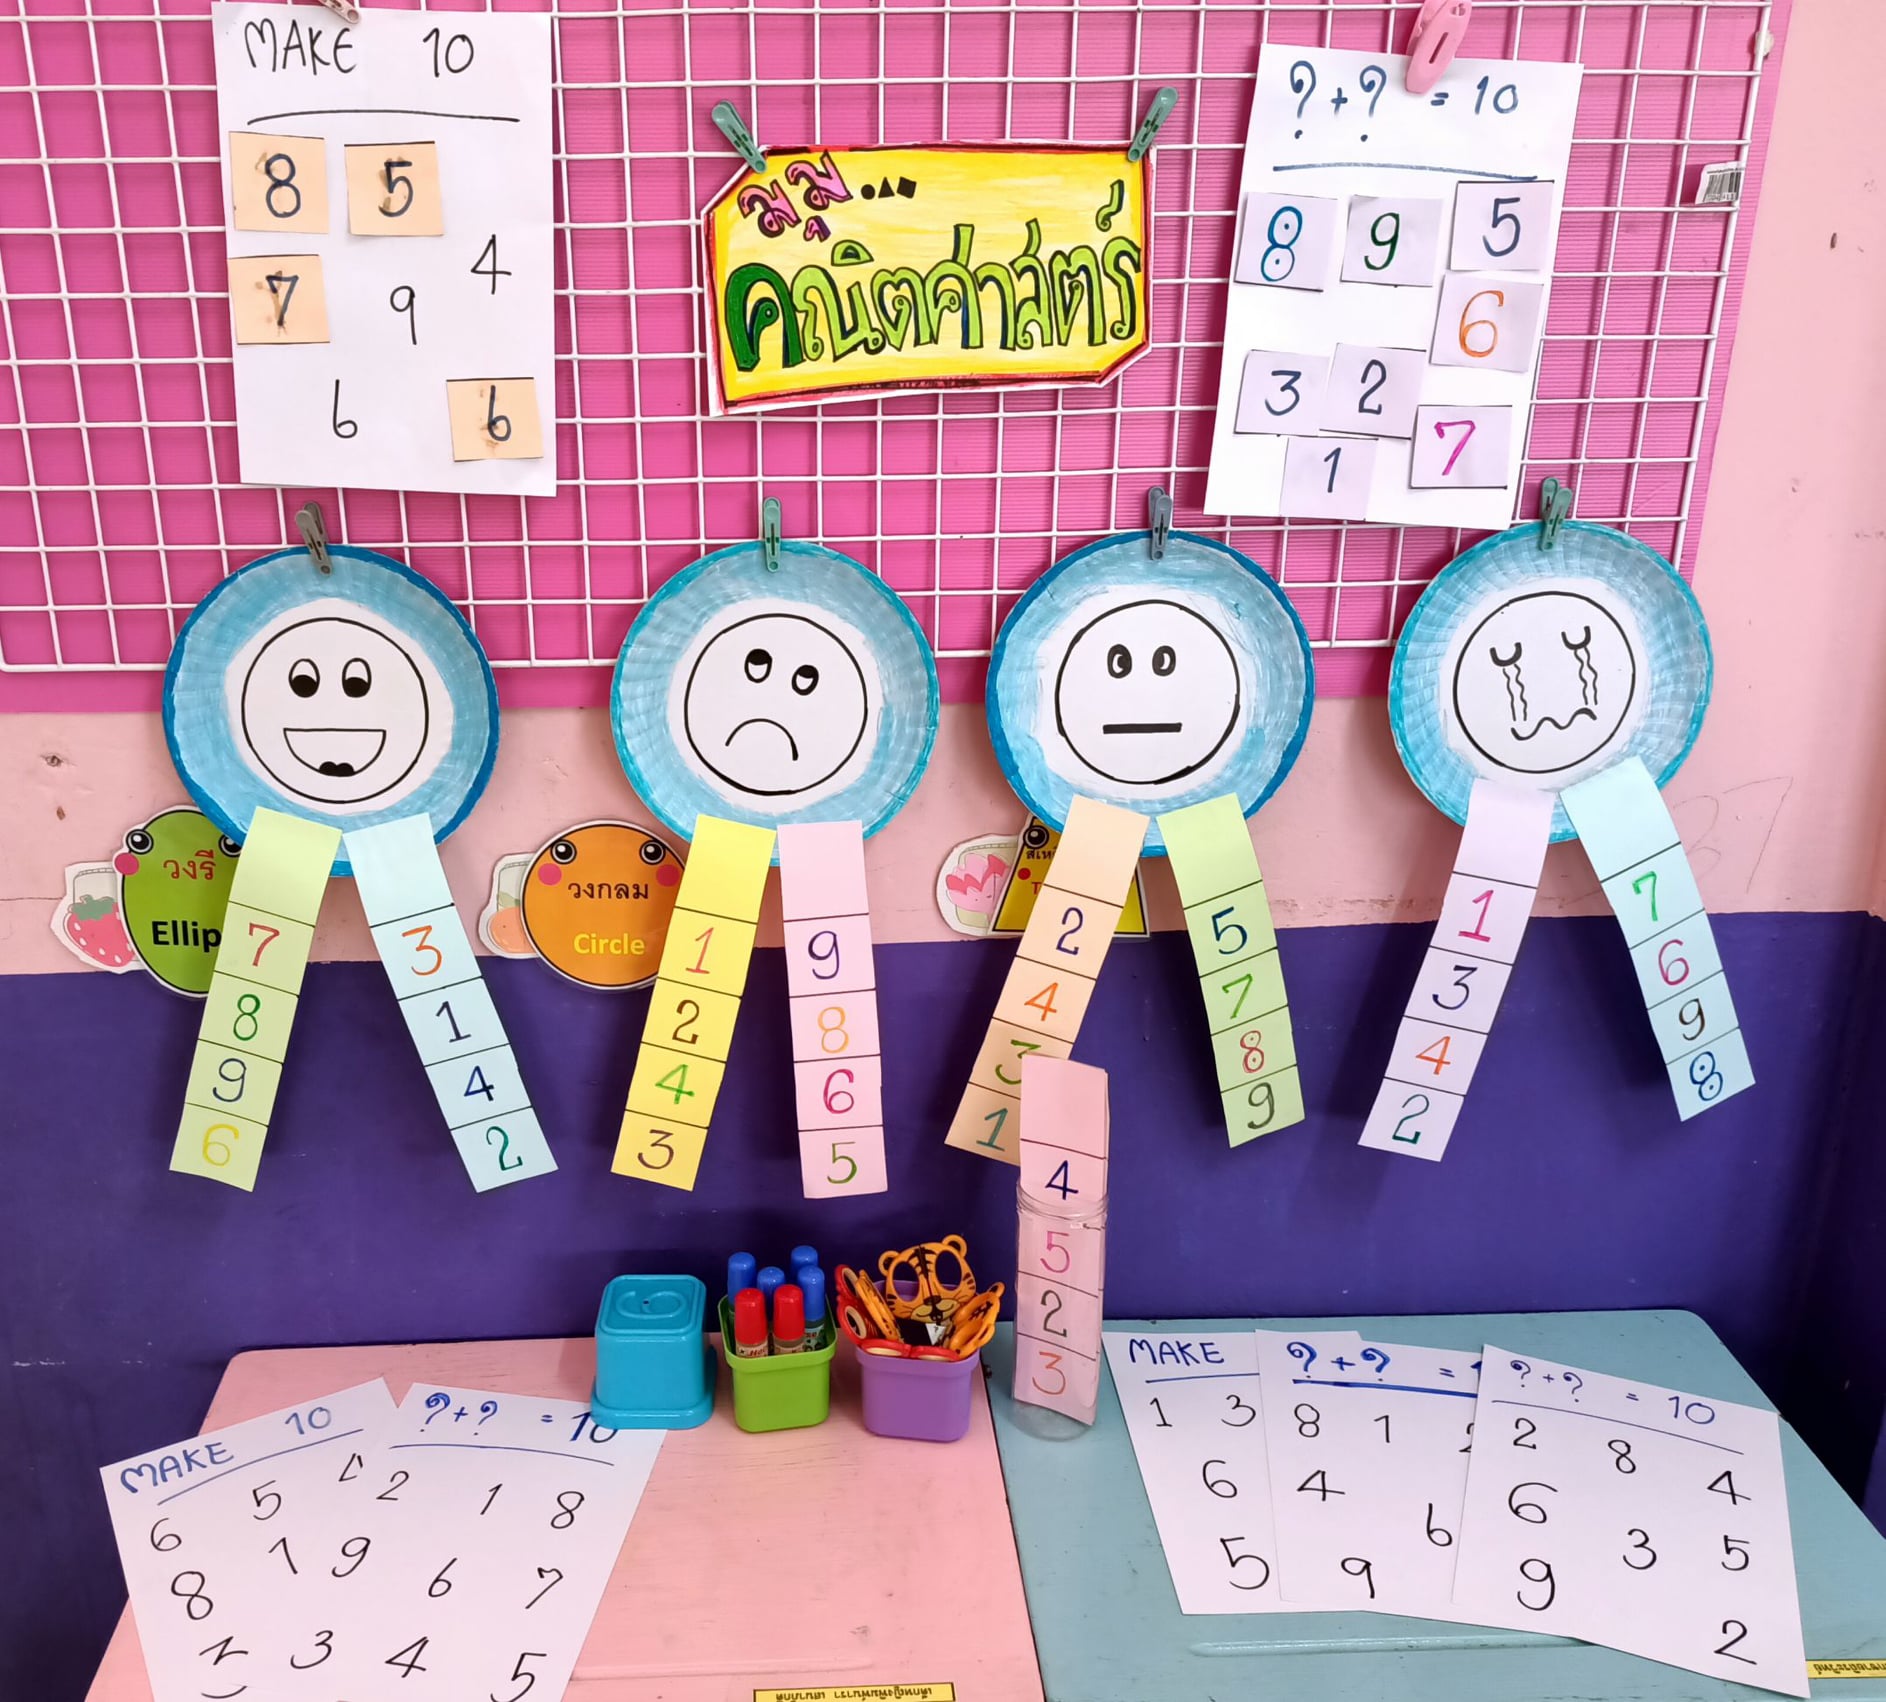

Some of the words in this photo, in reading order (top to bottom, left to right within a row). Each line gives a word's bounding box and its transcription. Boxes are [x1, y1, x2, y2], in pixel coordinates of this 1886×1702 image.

[244, 18, 357, 75] MAKE
[422, 27, 474, 77] 10
[1473, 75, 1519, 115] 10
[264, 153, 301, 218] 8
[378, 160, 414, 217] 5
[1260, 205, 1303, 282] 8
[1363, 211, 1401, 271] 9
[1482, 196, 1522, 258] 5
[470, 234, 512, 295] 4
[724, 178, 1142, 373] คณิตศาสตร์
[265, 273, 299, 328] 7
[389, 285, 417, 346] 9
[1458, 289, 1505, 359] 6
[332, 378, 359, 439] 6
[1264, 369, 1302, 417] 3
[1358, 358, 1388, 416] 2
[487, 384, 512, 442] 6
[1323, 446, 1342, 493] 1
[1434, 419, 1477, 476] 7
[163, 849, 216, 881] วงรี
[568, 882, 649, 899] วงกลม
[1631, 870, 1659, 922] 7
[151, 920, 222, 953] Ellip
[1055, 906, 1084, 956] 2
[1210, 906, 1249, 955] 5
[1457, 889, 1495, 943] 1
[248, 922, 281, 967] 7
[401, 924, 443, 976] 3
[573, 932, 646, 955] Circle
[685, 926, 715, 975] 1
[807, 929, 841, 980] 9
[1657, 938, 1690, 986] 6
[1023, 981, 1060, 1022] 4
[1221, 973, 1254, 1019] 7
[1432, 964, 1479, 1010] 3
[232, 993, 262, 1041] 8
[435, 1000, 472, 1044] 1
[671, 999, 701, 1045] 2
[816, 1005, 850, 1054] 8
[1678, 997, 1706, 1042] 9
[994, 1039, 1043, 1086] 3
[1239, 1030, 1265, 1074] 8
[1415, 1035, 1452, 1076] 4
[212, 1057, 247, 1103] 9
[463, 1065, 495, 1102] 4
[654, 1063, 696, 1105] 4
[822, 1068, 855, 1115] 6
[1688, 1050, 1724, 1102] 8
[1247, 1081, 1276, 1130] 9
[1391, 1093, 1431, 1145] 2
[201, 1123, 240, 1167] 6
[485, 1126, 524, 1171] 2
[636, 1128, 676, 1170] 3
[975, 1107, 1009, 1152] 1
[826, 1141, 858, 1185] 5
[1045, 1159, 1079, 1200] 4
[1040, 1230, 1071, 1274] 5
[1040, 1289, 1068, 1338] 2
[1031, 1351, 1067, 1396] 3
[1128, 1338, 1225, 1367] MAKE
[1149, 1397, 1173, 1428] 1
[1221, 1394, 1257, 1428] 3
[1294, 1402, 1321, 1439] 8
[1668, 1395, 1716, 1425] 10
[120, 1442, 235, 1494] MAKE
[285, 1406, 332, 1435] 10
[1512, 1416, 1537, 1450] 2
[1201, 1459, 1238, 1499] 6
[1607, 1439, 1637, 1475] 8
[252, 1479, 282, 1521] 5
[376, 1470, 410, 1501] 2
[480, 1483, 503, 1516] 1
[1297, 1469, 1346, 1502] 4
[1507, 1481, 1559, 1524] 6
[1707, 1470, 1752, 1505] 4
[550, 1490, 585, 1530] 8
[1426, 1502, 1453, 1547] 6
[150, 1517, 183, 1552] 6
[331, 1536, 372, 1578] 9
[1622, 1528, 1657, 1570] 3
[1720, 1534, 1750, 1572] 5
[428, 1557, 458, 1598] 6
[1219, 1536, 1270, 1590] 5
[1340, 1556, 1376, 1599] 9
[1516, 1558, 1556, 1611] 9
[170, 1570, 214, 1621] 8
[525, 1567, 564, 1610] 7
[289, 1629, 334, 1670] 3
[385, 1636, 429, 1679] 4
[1713, 1619, 1758, 1665] 2
[490, 1652, 548, 1702] 5
